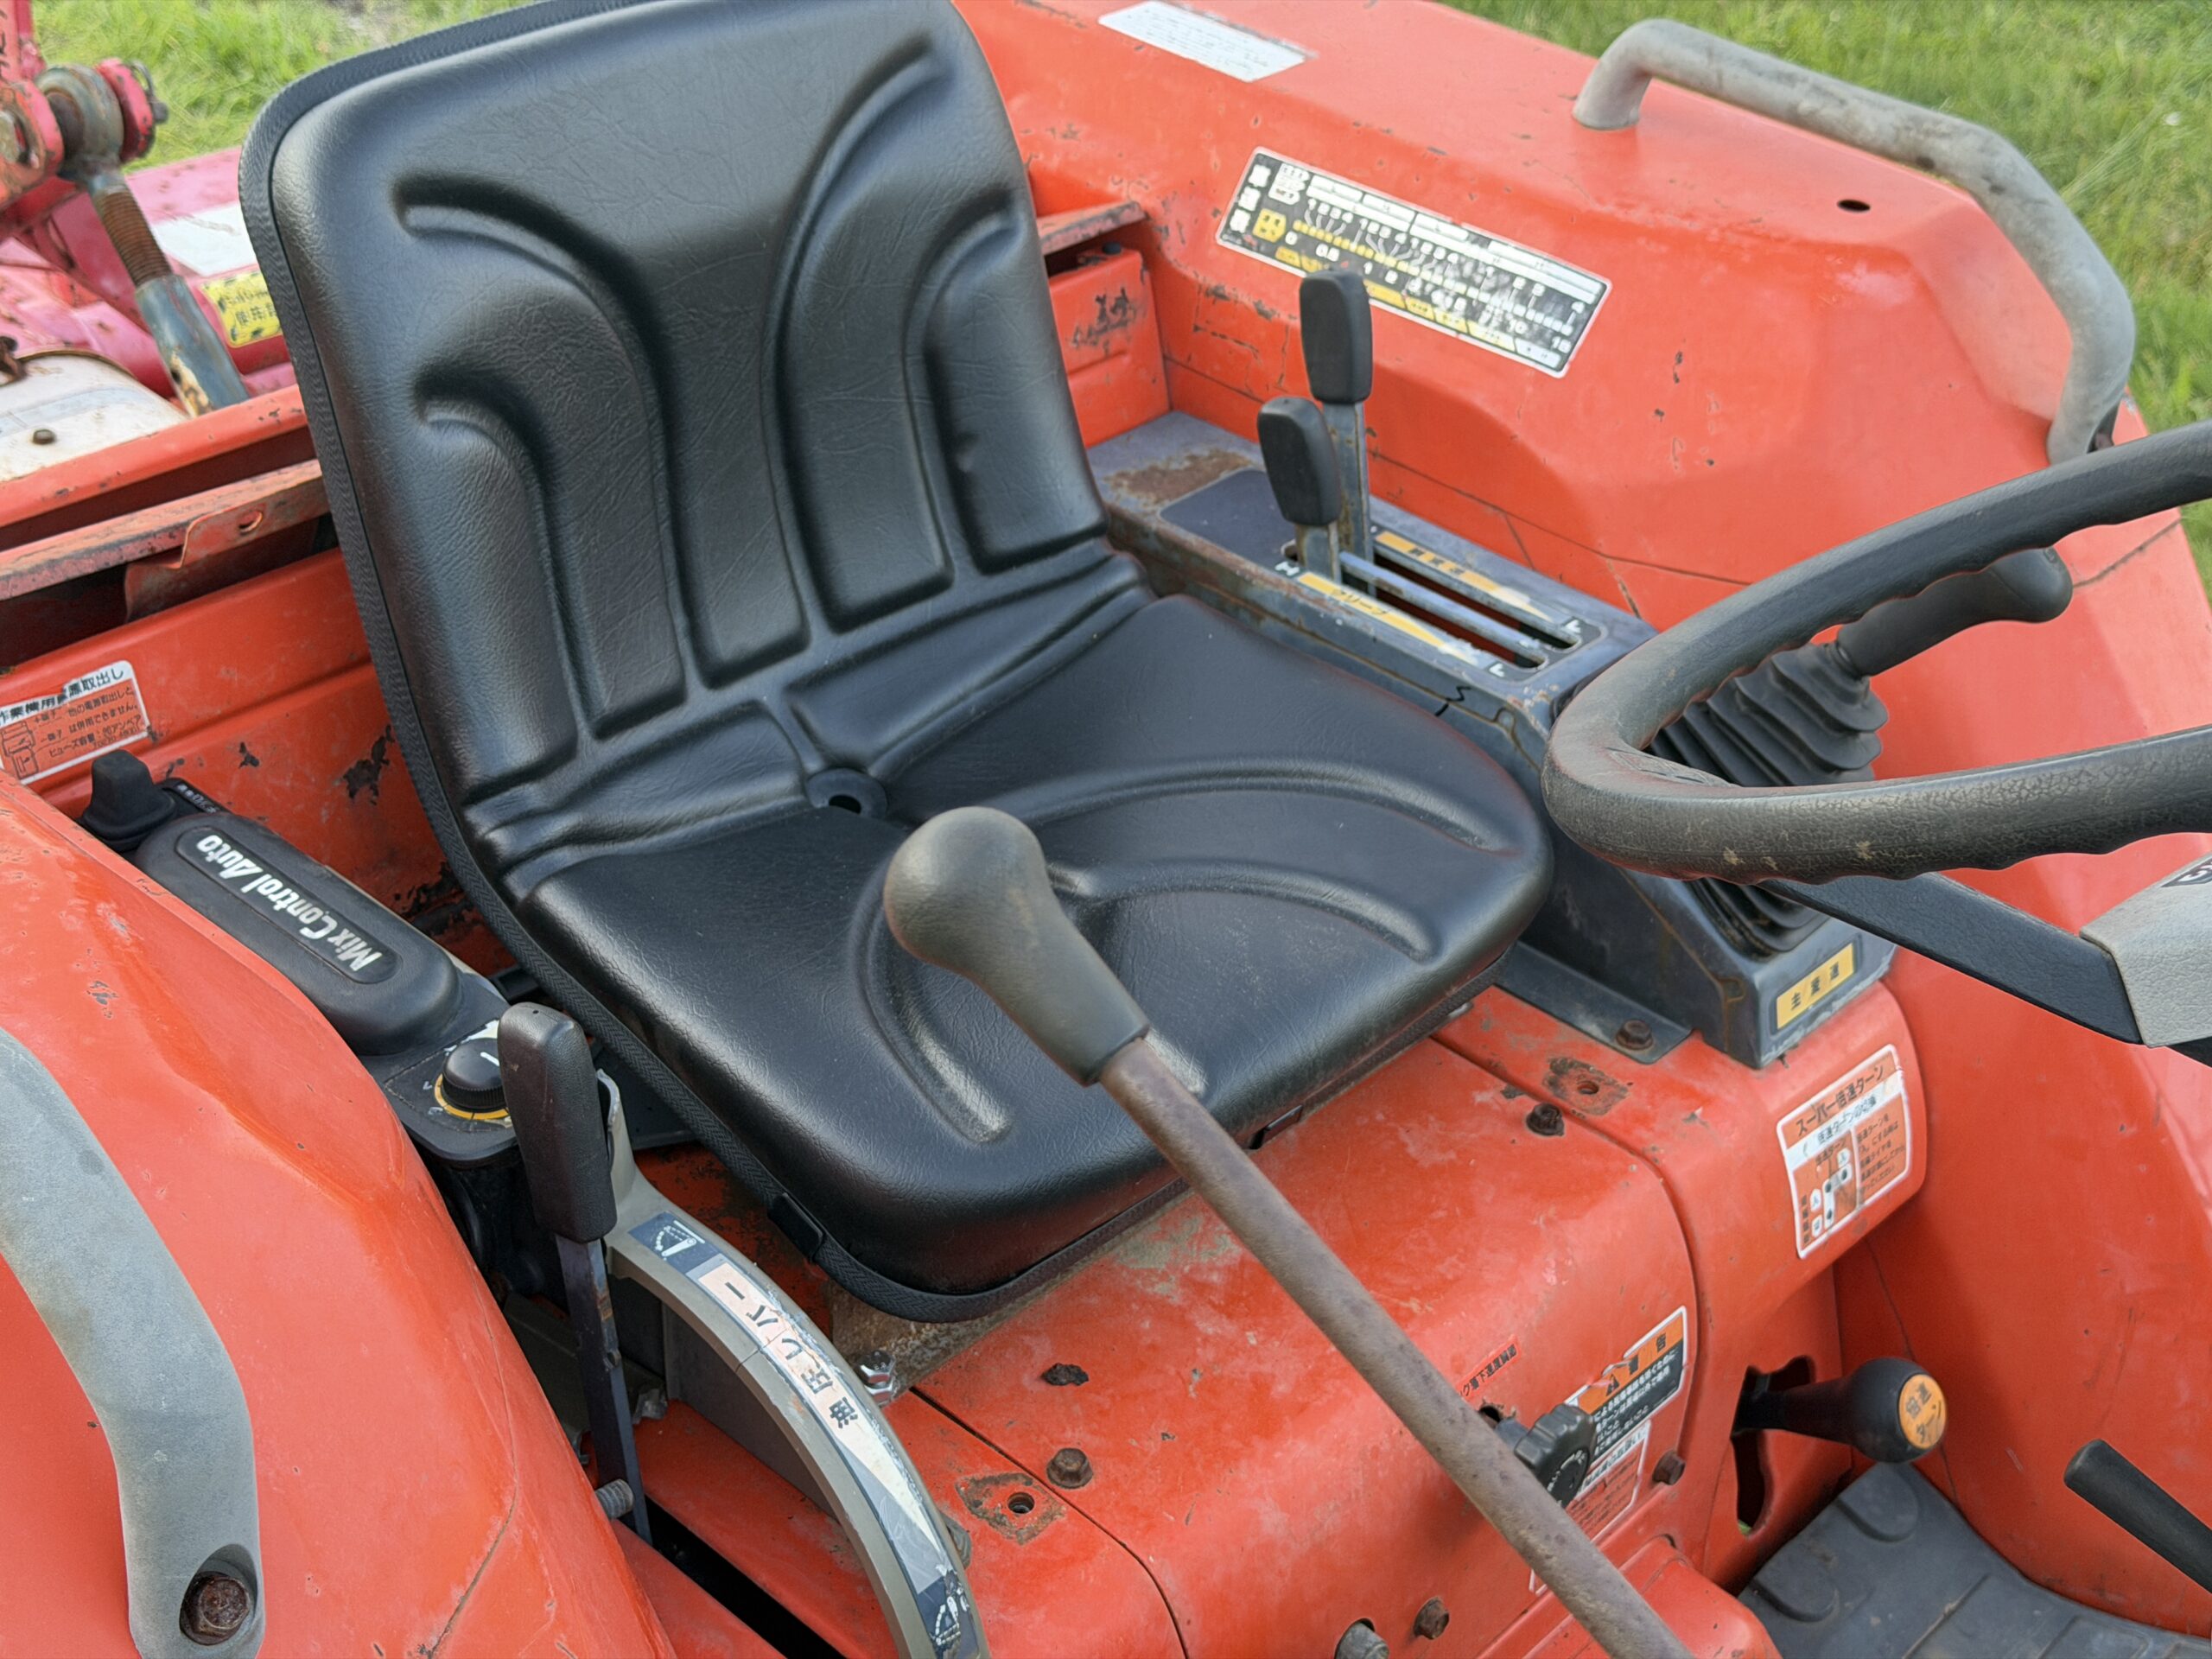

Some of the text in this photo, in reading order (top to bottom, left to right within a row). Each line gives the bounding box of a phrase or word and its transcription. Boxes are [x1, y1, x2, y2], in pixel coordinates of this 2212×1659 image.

[196, 833, 383, 972] Mix Control Auto
[724, 1280, 858, 1430] 油圧レバー
